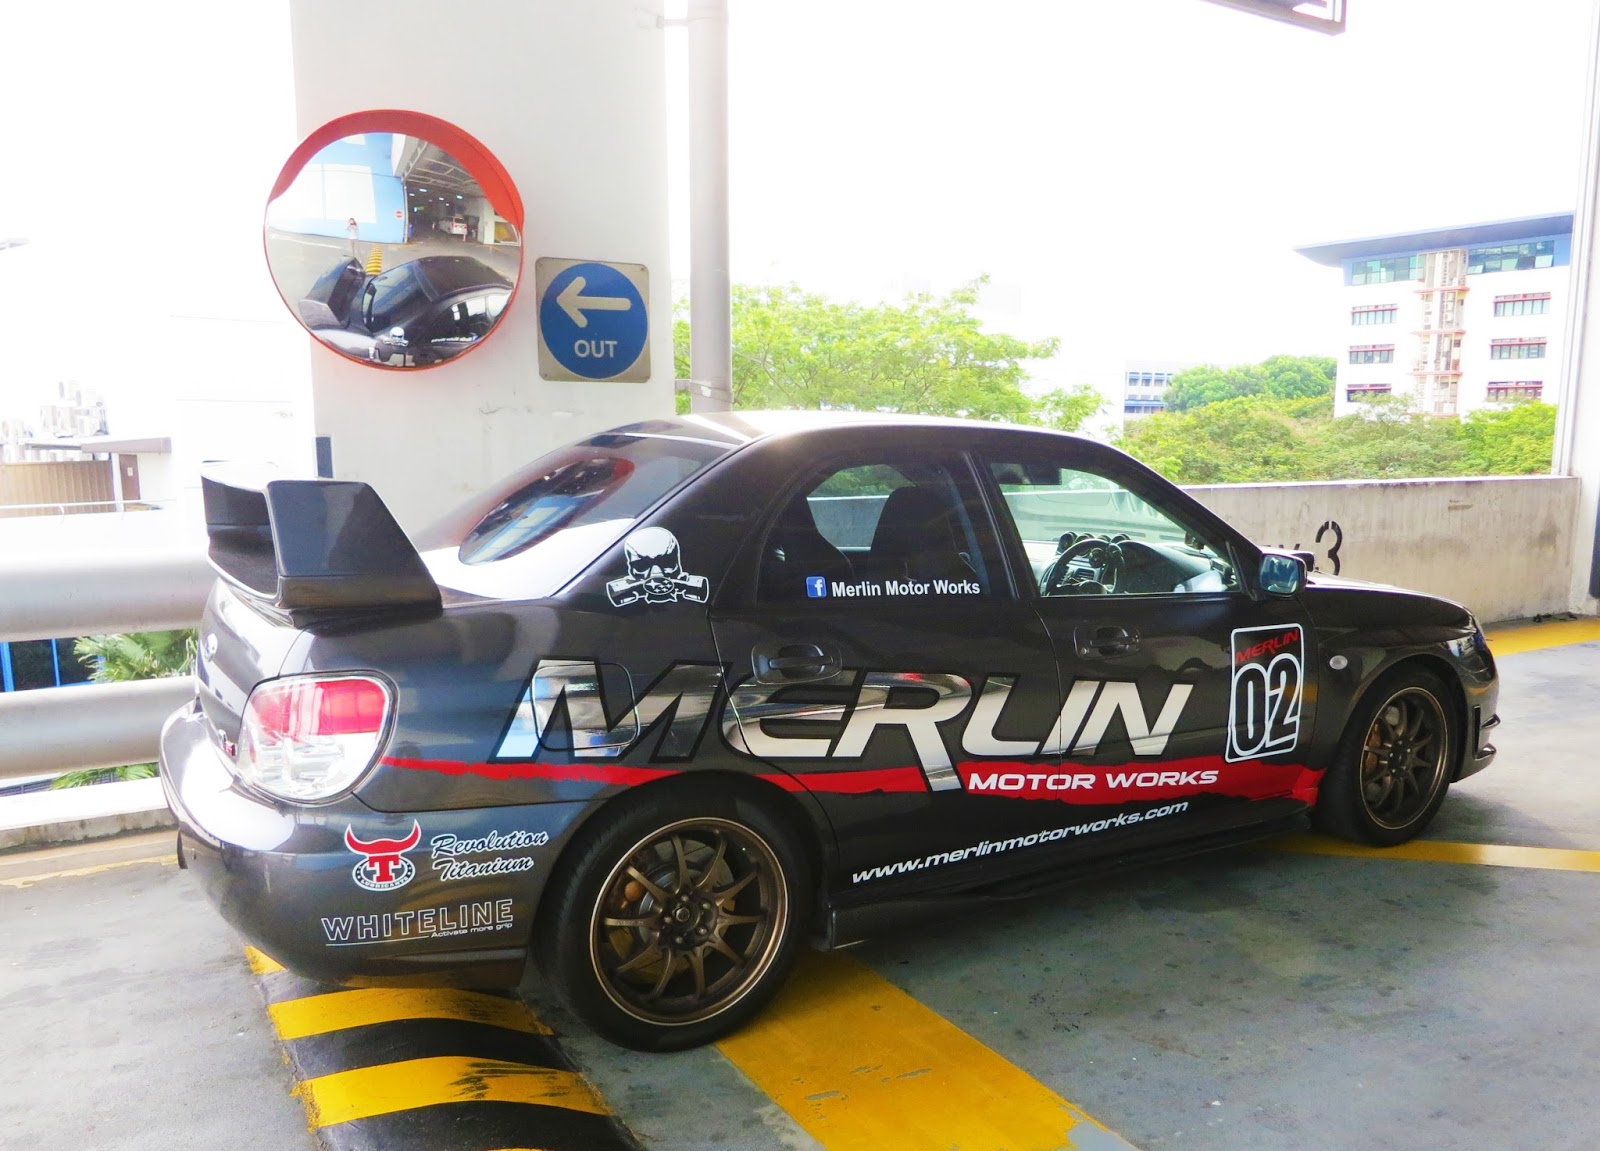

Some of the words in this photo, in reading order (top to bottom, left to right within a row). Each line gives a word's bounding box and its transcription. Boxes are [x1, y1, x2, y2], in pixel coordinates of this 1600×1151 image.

[574, 339, 617, 358] OUT
[1315, 520, 1343, 576] 3
[832, 581, 881, 597] Merlin
[885, 580, 930, 596] Motor
[933, 579, 981, 595] Works
[1235, 629, 1299, 663] MERLIN
[1232, 652, 1300, 757] 02
[490, 655, 1196, 795] MERLIN
[968, 773, 1096, 791] MOTOR
[1105, 769, 1219, 789] WORKS
[430, 830, 549, 859] Revolution
[852, 801, 1189, 884] www.merlinmotorworks.com
[432, 857, 534, 881] Titanium
[321, 899, 514, 941] WHITELINE
[431, 928, 468, 938] Activate
[470, 924, 494, 933] more
[496, 922, 513, 932] grip
